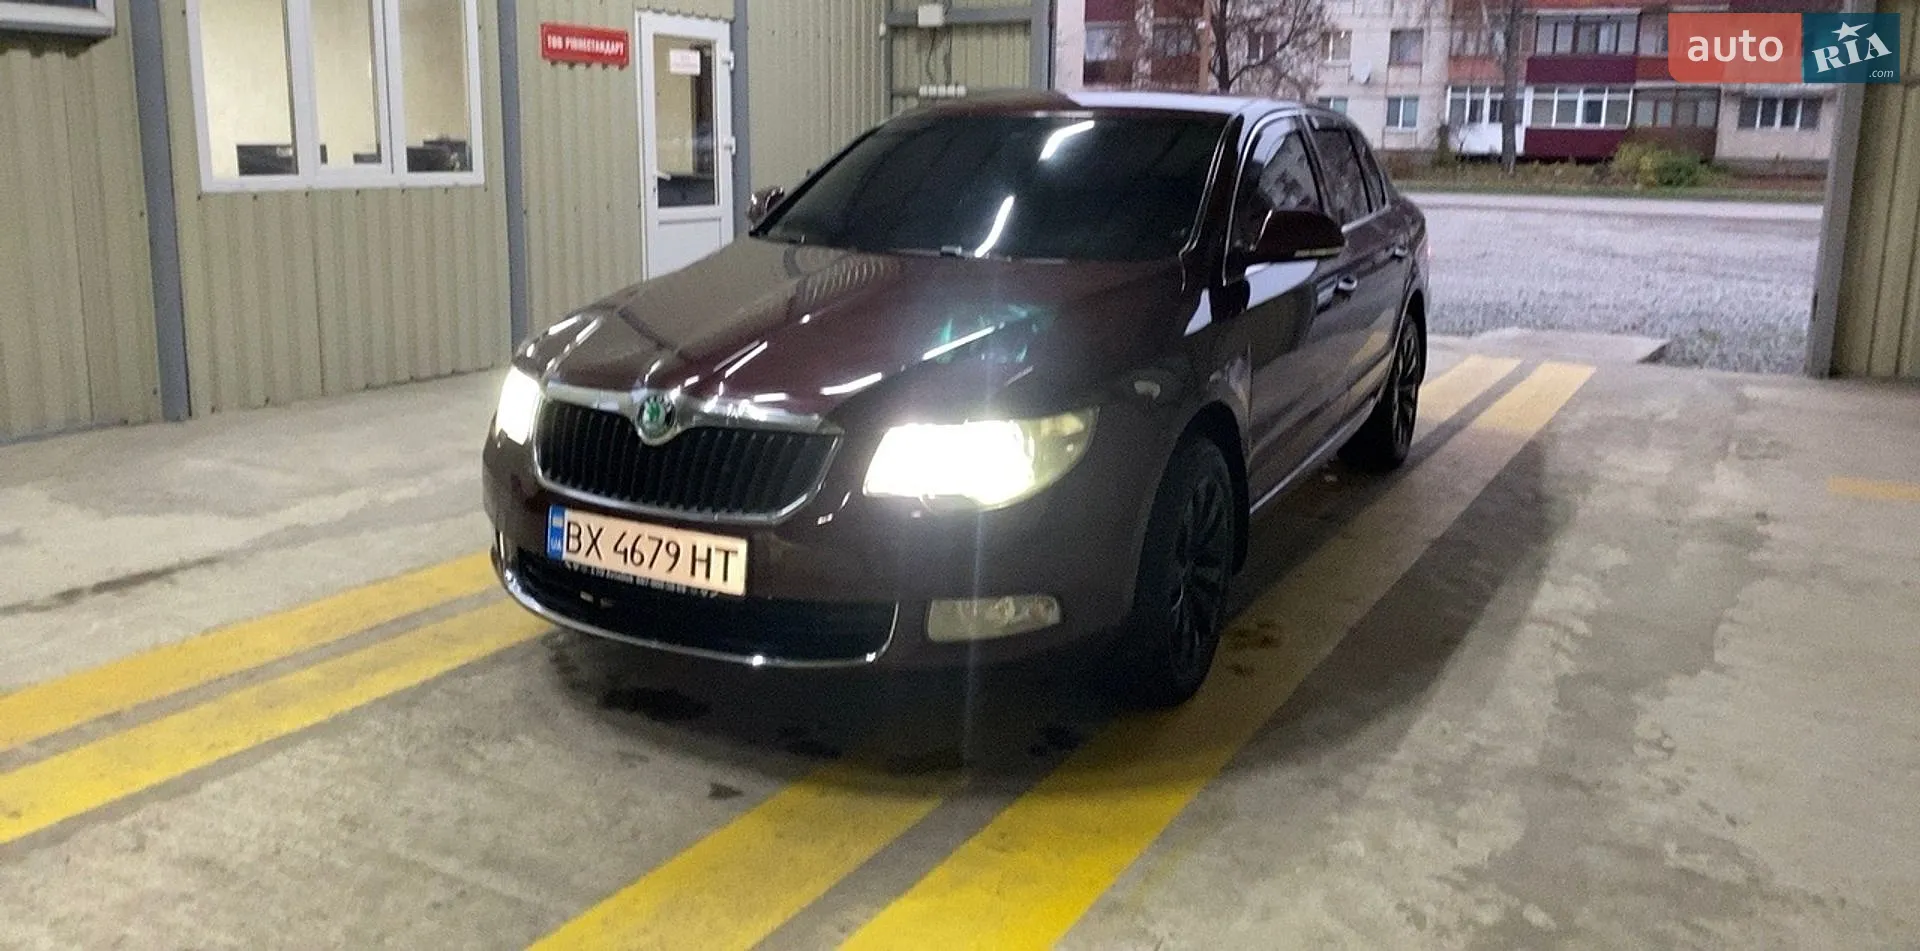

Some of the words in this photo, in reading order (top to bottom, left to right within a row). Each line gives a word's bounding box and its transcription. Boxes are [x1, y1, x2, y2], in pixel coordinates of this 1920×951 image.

[550, 536, 562, 551] UA
[566, 521, 604, 561] BX
[613, 529, 682, 573] 4679
[690, 543, 739, 583] HT
